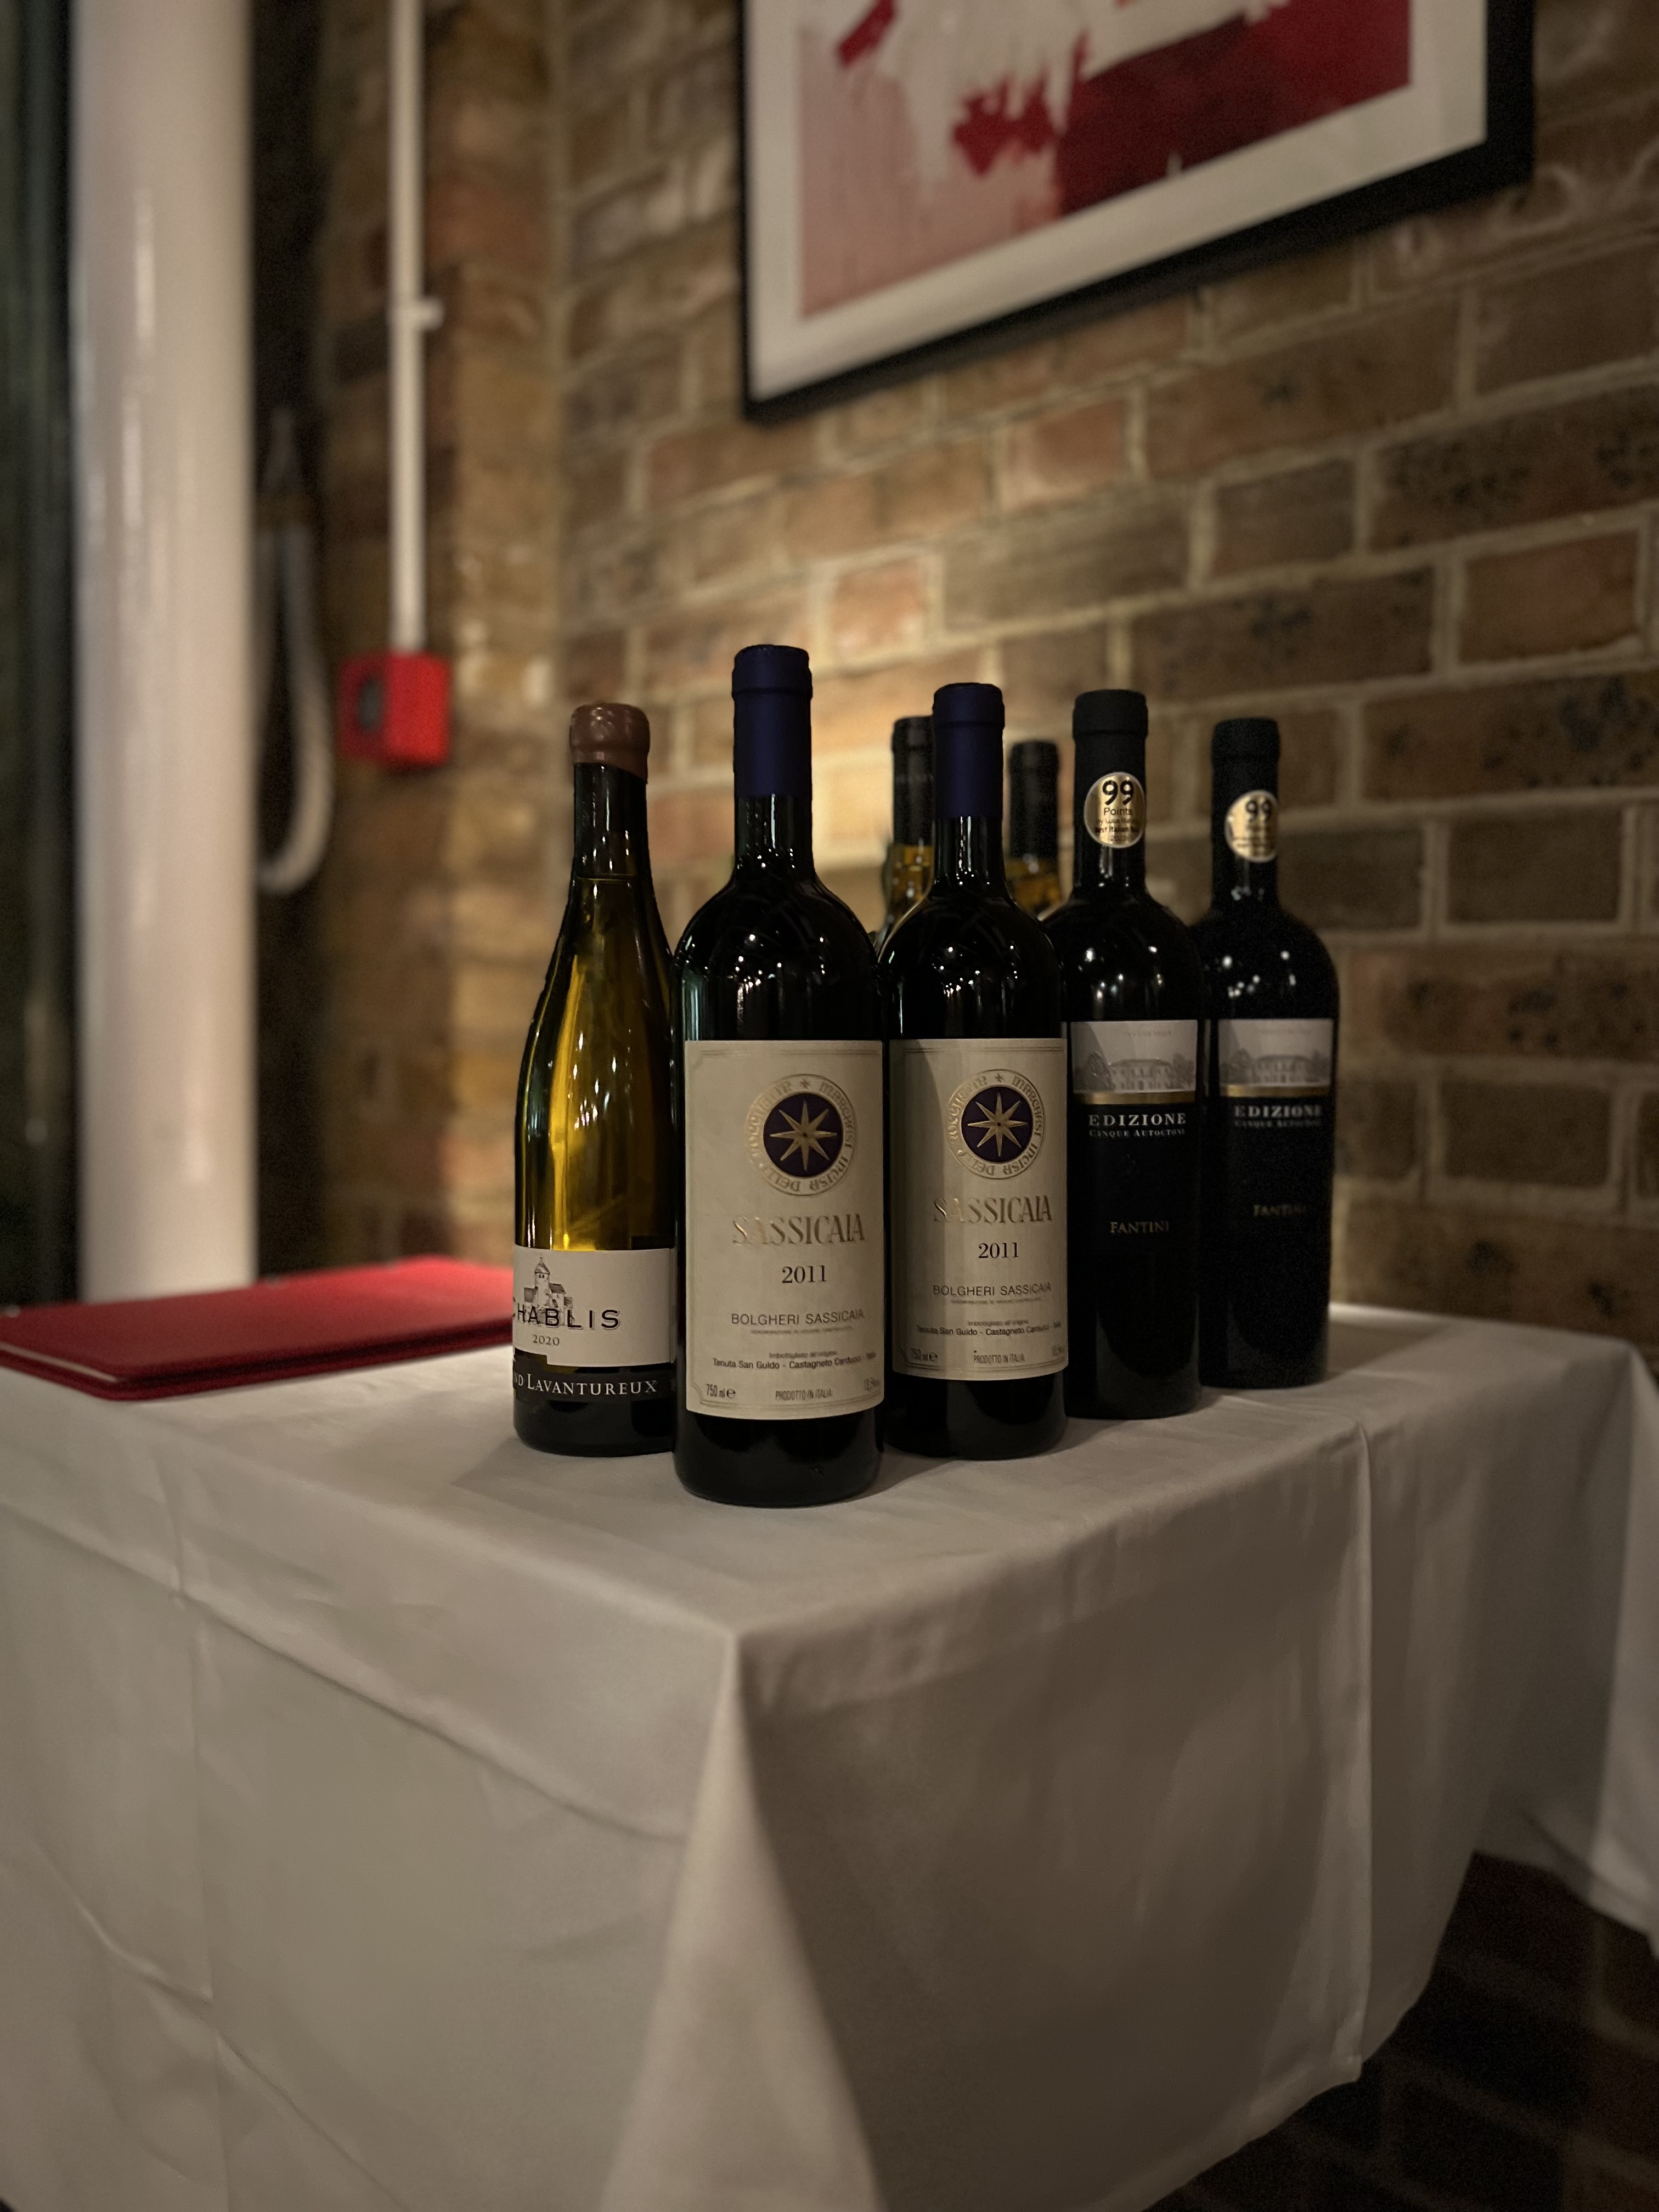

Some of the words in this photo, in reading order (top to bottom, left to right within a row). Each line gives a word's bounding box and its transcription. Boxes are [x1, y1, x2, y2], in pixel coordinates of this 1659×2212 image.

[1103, 780, 1134, 806] 99
[1104, 808, 1132, 816] Points
[1246, 799, 1272, 822] 99
[1089, 1113, 1186, 1126] EDIZIONE
[934, 1194, 1052, 1224] SASSICAIA
[732, 1213, 866, 1245] SASSICAIA
[1110, 1221, 1169, 1233] FANTINI
[979, 1242, 1019, 1259] 2011
[782, 1265, 827, 1284] 2011
[933, 1285, 995, 1296] BOLGHERI
[1000, 1282, 1052, 1296] SASSICAIA
[513, 1296, 620, 1330] HABLIS
[732, 1313, 799, 1325] BOLGHERI
[805, 1309, 864, 1324] SASSICAIA
[533, 1334, 560, 1346] 2020
[713, 1357, 736, 1368] Tenuta
[757, 1361, 780, 1369] Guido
[789, 1359, 832, 1369] Castagneto
[527, 1373, 657, 1396] LAVANTUREUX
[775, 1390, 806, 1401] PRODOTTO
